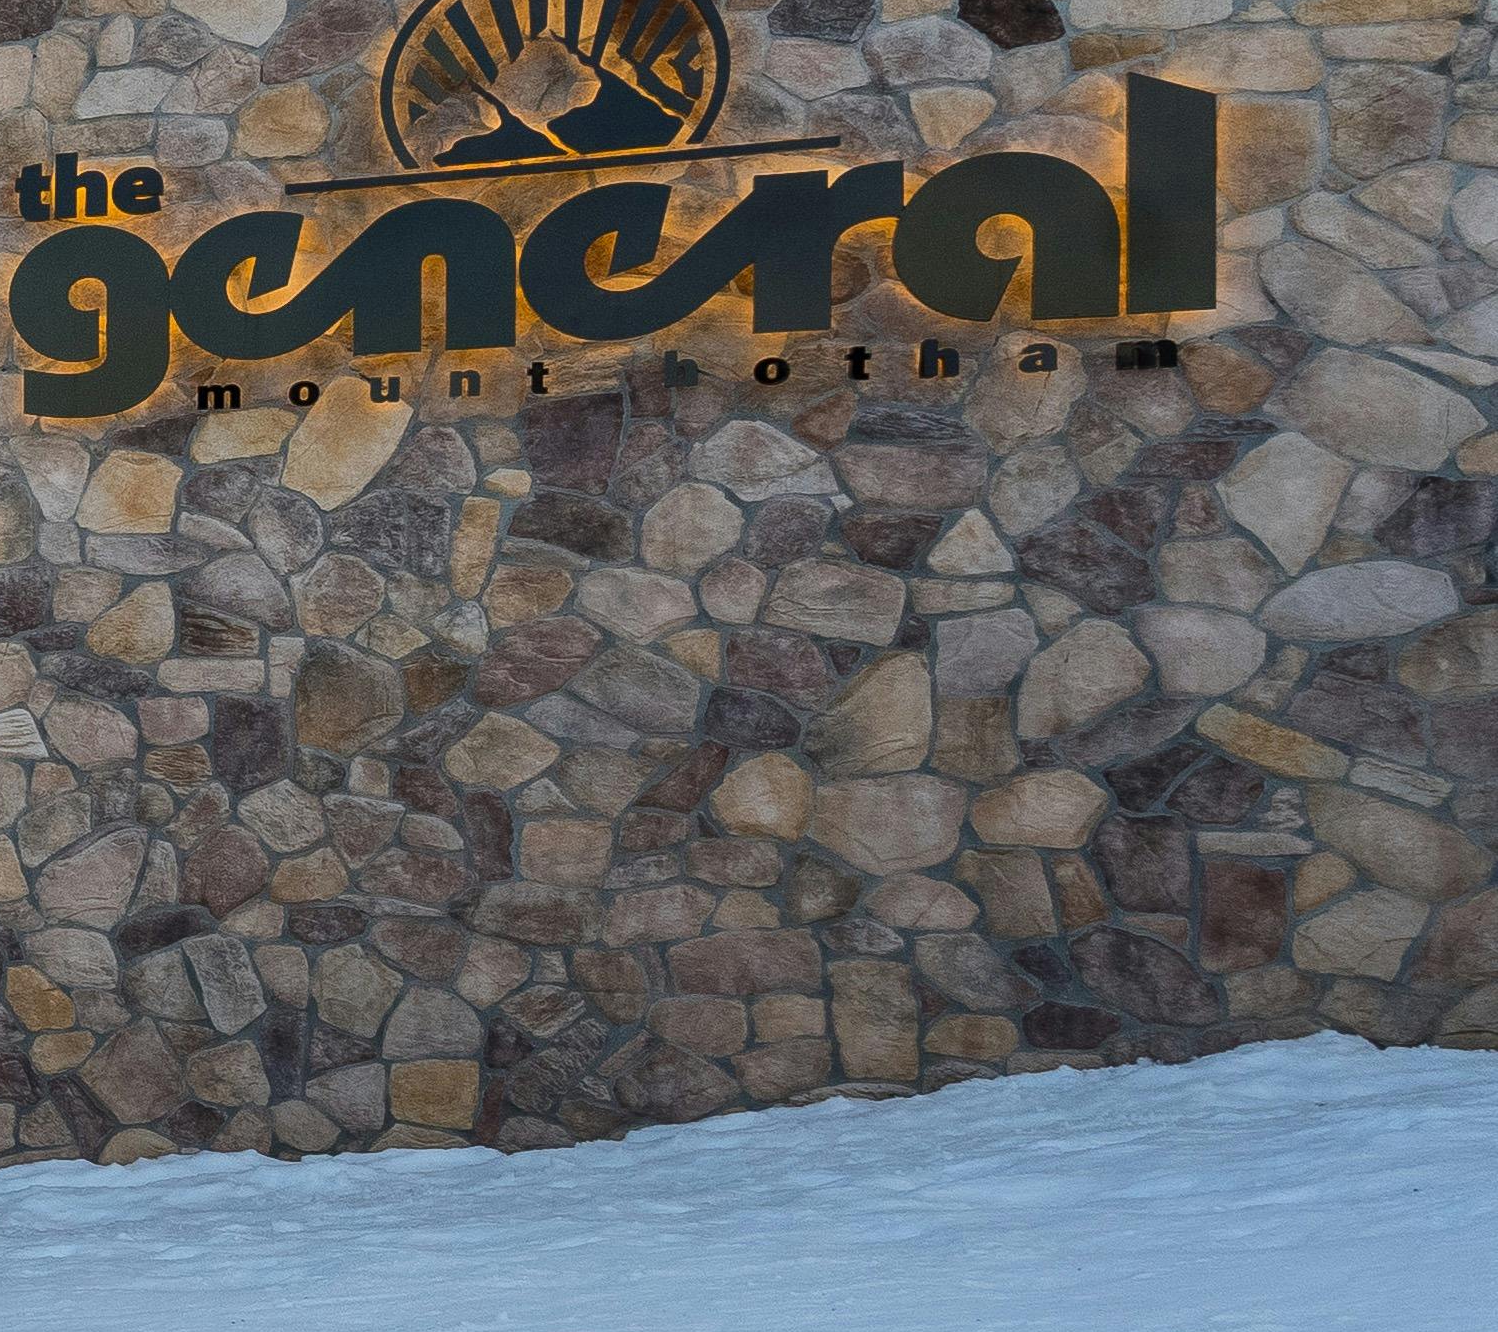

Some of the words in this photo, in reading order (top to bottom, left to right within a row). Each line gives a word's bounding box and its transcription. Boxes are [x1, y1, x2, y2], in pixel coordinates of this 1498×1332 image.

[15, 153, 164, 221] the
[9, 72, 1217, 418] general
[197, 362, 549, 410] mount
[664, 338, 1178, 388] hotham
